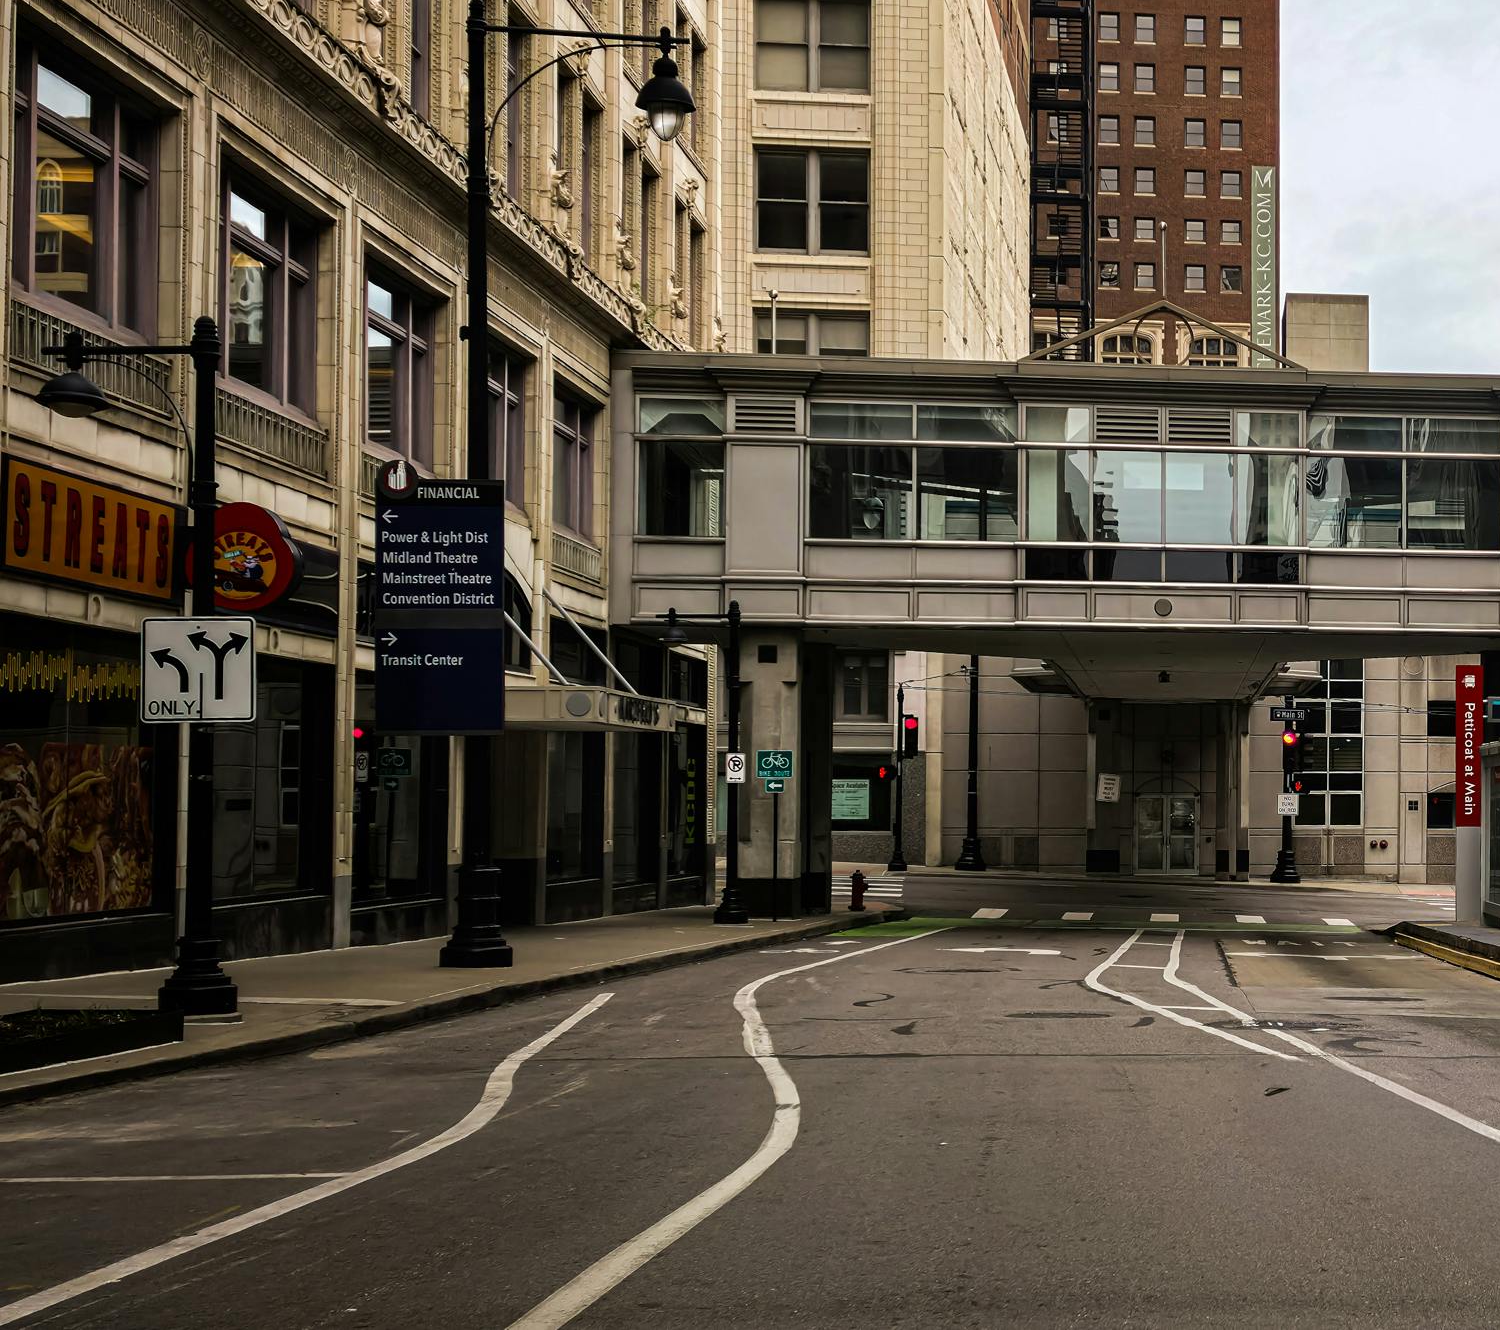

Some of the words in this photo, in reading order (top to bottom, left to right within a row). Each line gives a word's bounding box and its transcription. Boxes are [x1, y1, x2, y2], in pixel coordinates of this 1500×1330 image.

[417, 487, 480, 499] FINANCIAL
[13, 473, 169, 588] STREATS
[381, 531, 418, 543] Power
[421, 531, 430, 543] &
[433, 531, 463, 547] Light
[465, 532, 489, 544] Dist
[382, 551, 432, 564] Midland
[434, 552, 478, 564] Theatre
[382, 572, 446, 584] Mainstreet
[448, 572, 492, 584] Theatre
[382, 593, 450, 605] Convention
[453, 593, 495, 605] District
[381, 654, 422, 666] Transit
[424, 654, 463, 666] Center
[148, 700, 197, 715] ONLY
[1465, 702, 1476, 760] Petticoat
[1465, 765, 1475, 777] at
[685, 758, 696, 843] KCDC
[1465, 782, 1476, 815] Main
